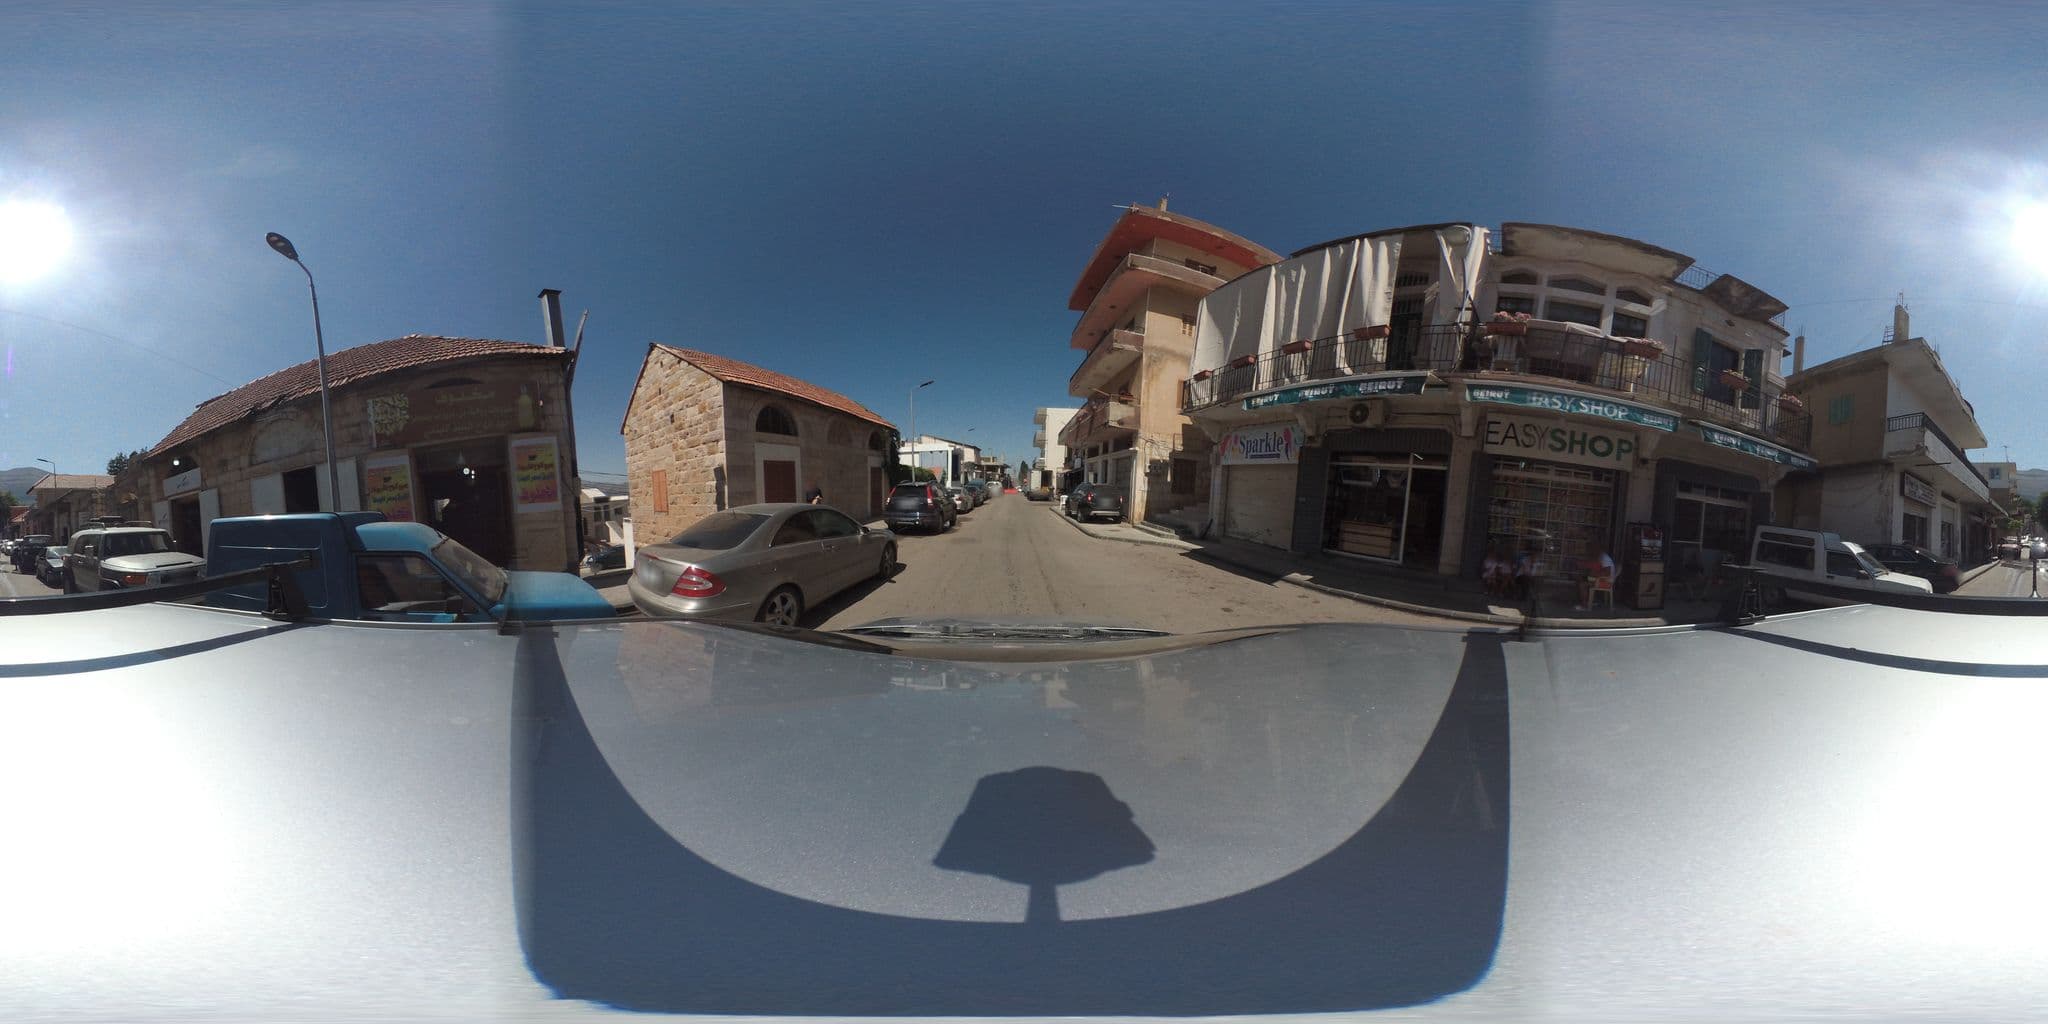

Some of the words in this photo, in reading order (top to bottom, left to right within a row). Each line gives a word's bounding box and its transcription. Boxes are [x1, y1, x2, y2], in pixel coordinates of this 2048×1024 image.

[1528, 392, 1576, 410] EASY
[1579, 399, 1629, 419] SHOP
[1240, 431, 1284, 459] Sparkle
